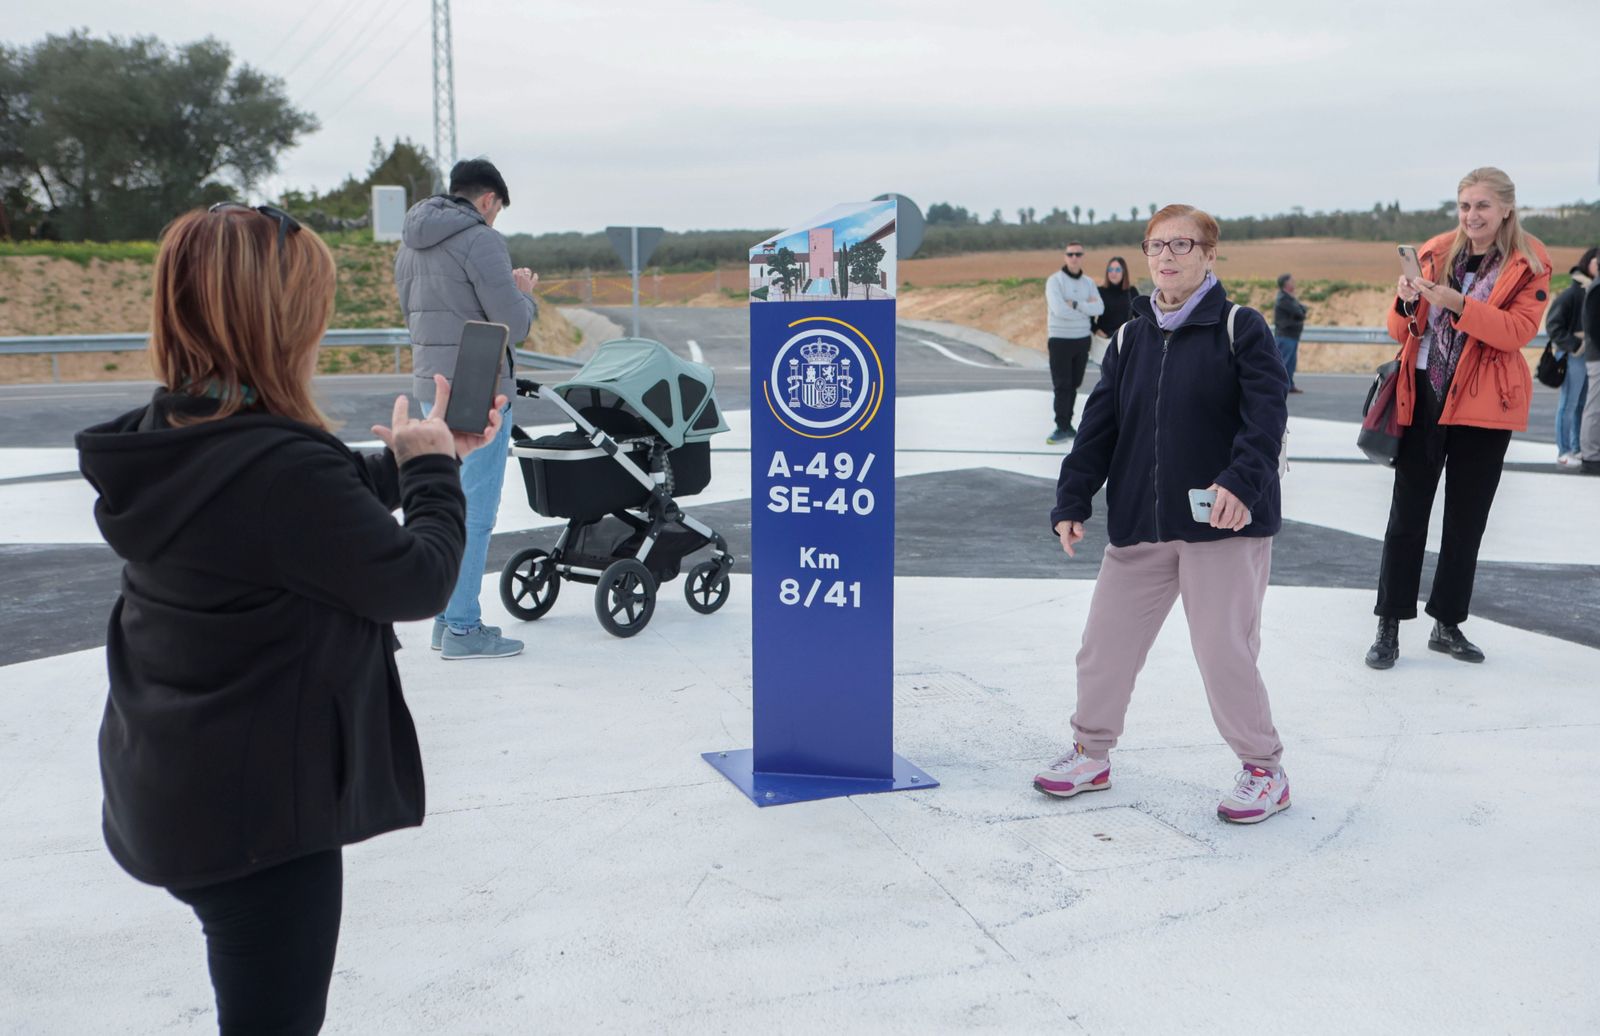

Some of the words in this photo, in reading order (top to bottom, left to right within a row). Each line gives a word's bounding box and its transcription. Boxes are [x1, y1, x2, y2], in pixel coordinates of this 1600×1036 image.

[767, 451, 875, 482] A-49/
[767, 486, 875, 515] SE-40
[800, 547, 840, 569] Km
[780, 579, 861, 608] 8/41
